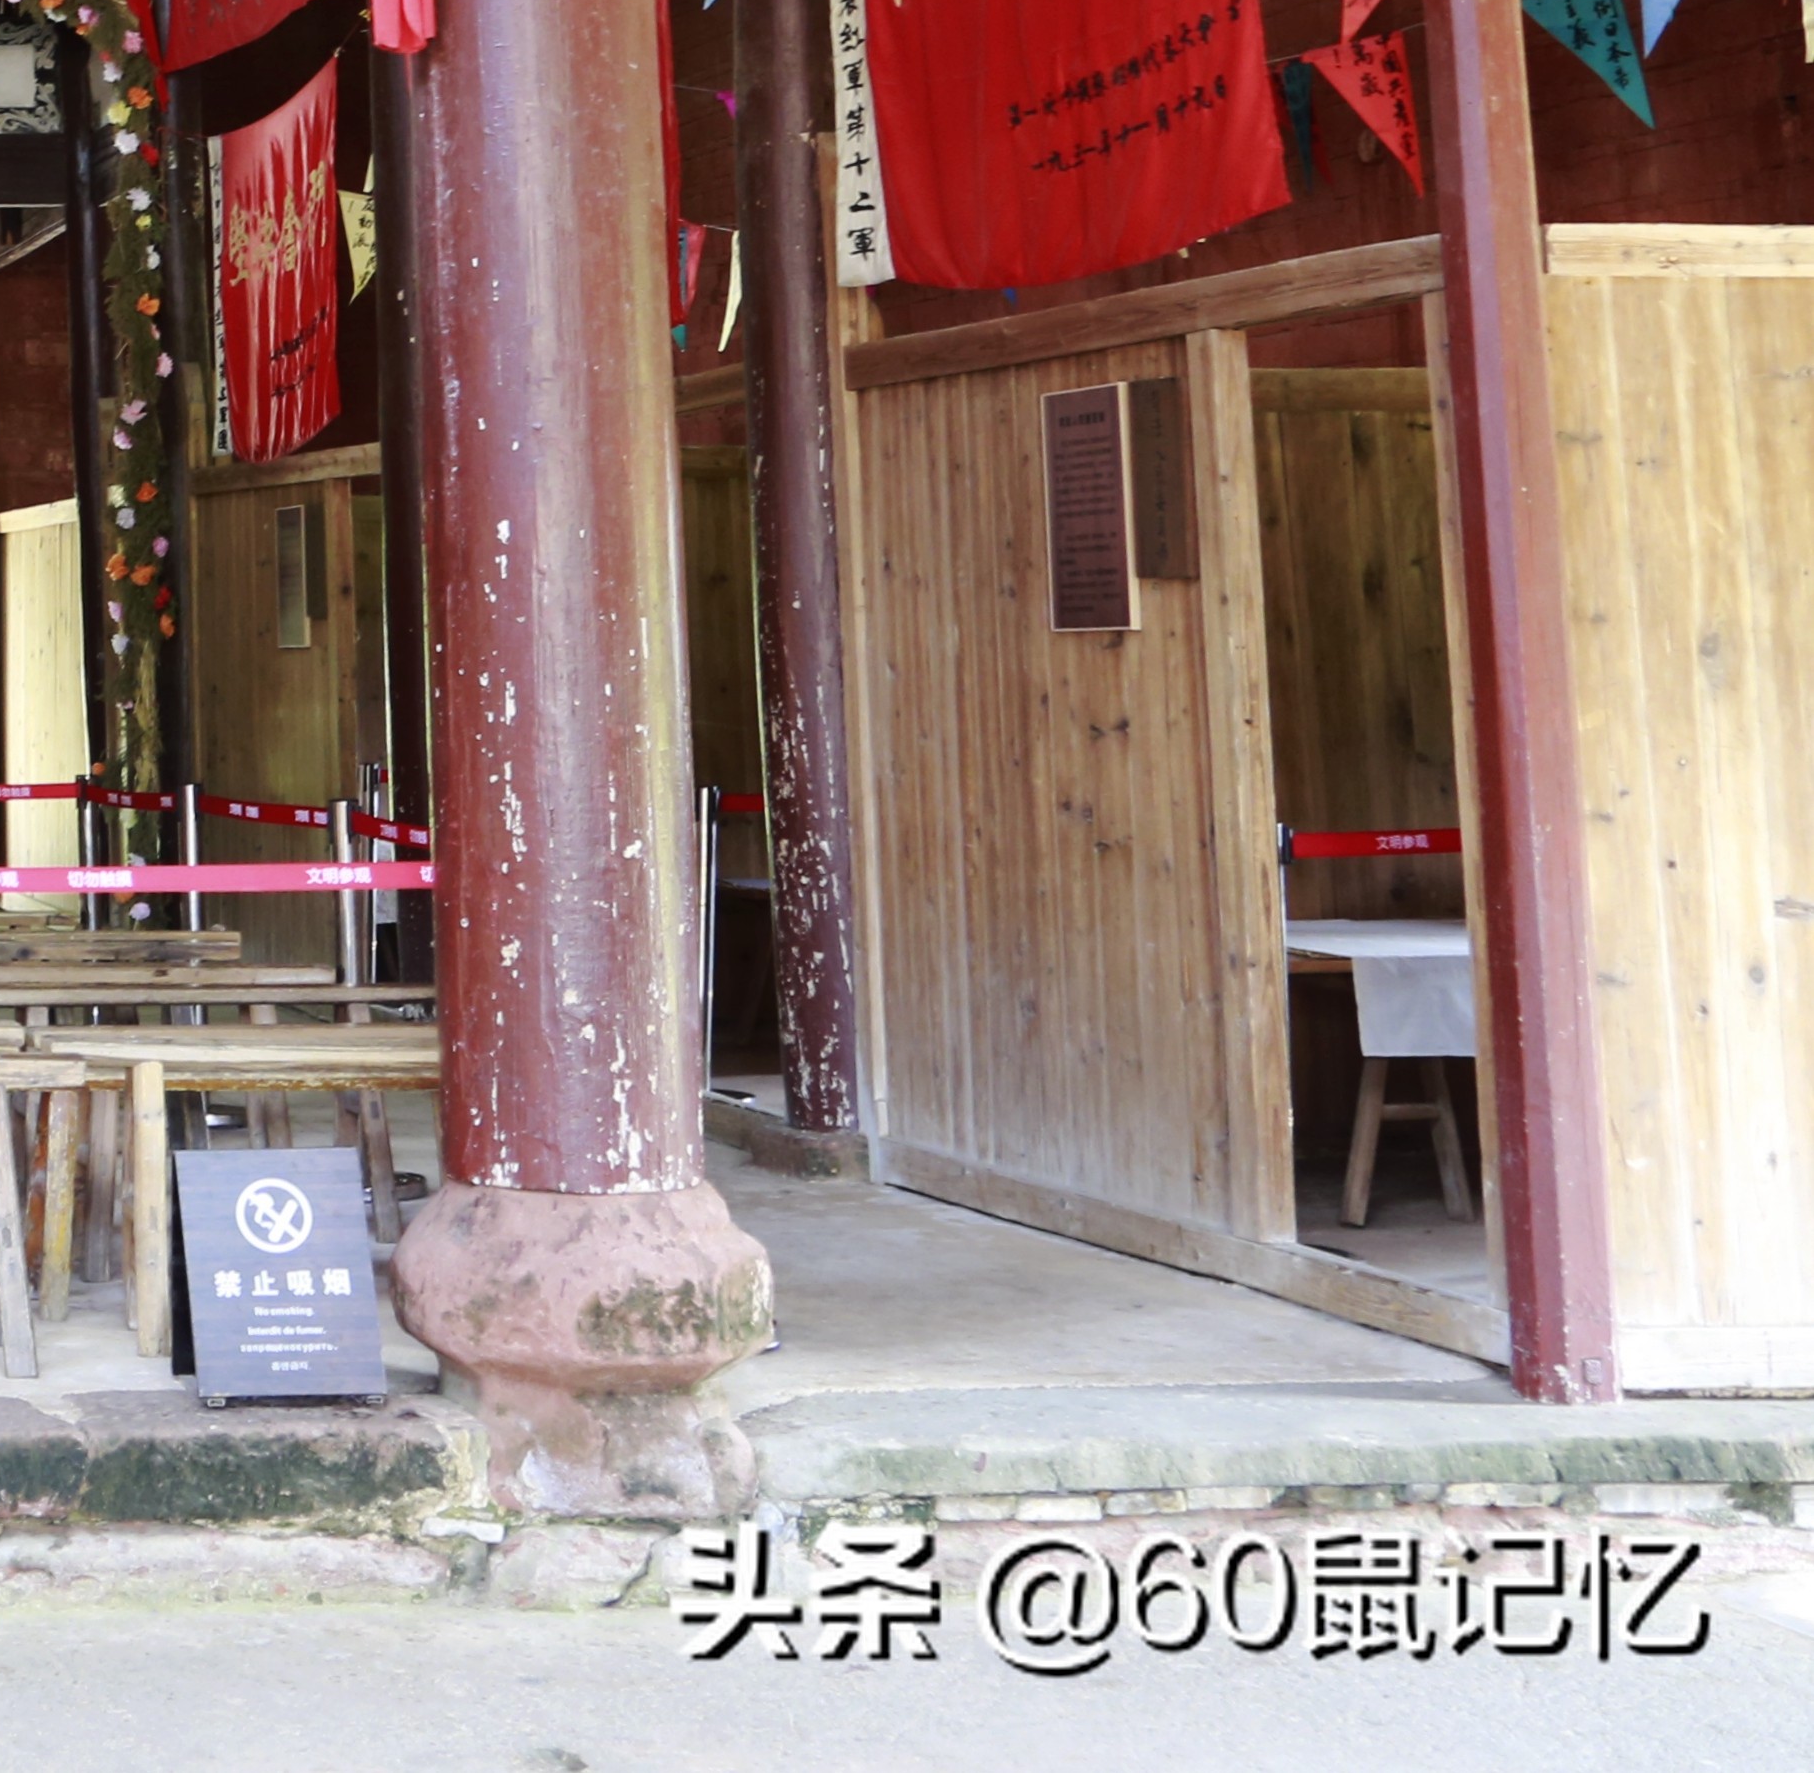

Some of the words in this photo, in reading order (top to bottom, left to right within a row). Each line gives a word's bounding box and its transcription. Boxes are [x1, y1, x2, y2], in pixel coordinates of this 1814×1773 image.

[67, 870, 133, 889] 切勿触摸
[305, 866, 372, 885] 文明参观
[214, 1268, 352, 1299] 禁止吸烟
